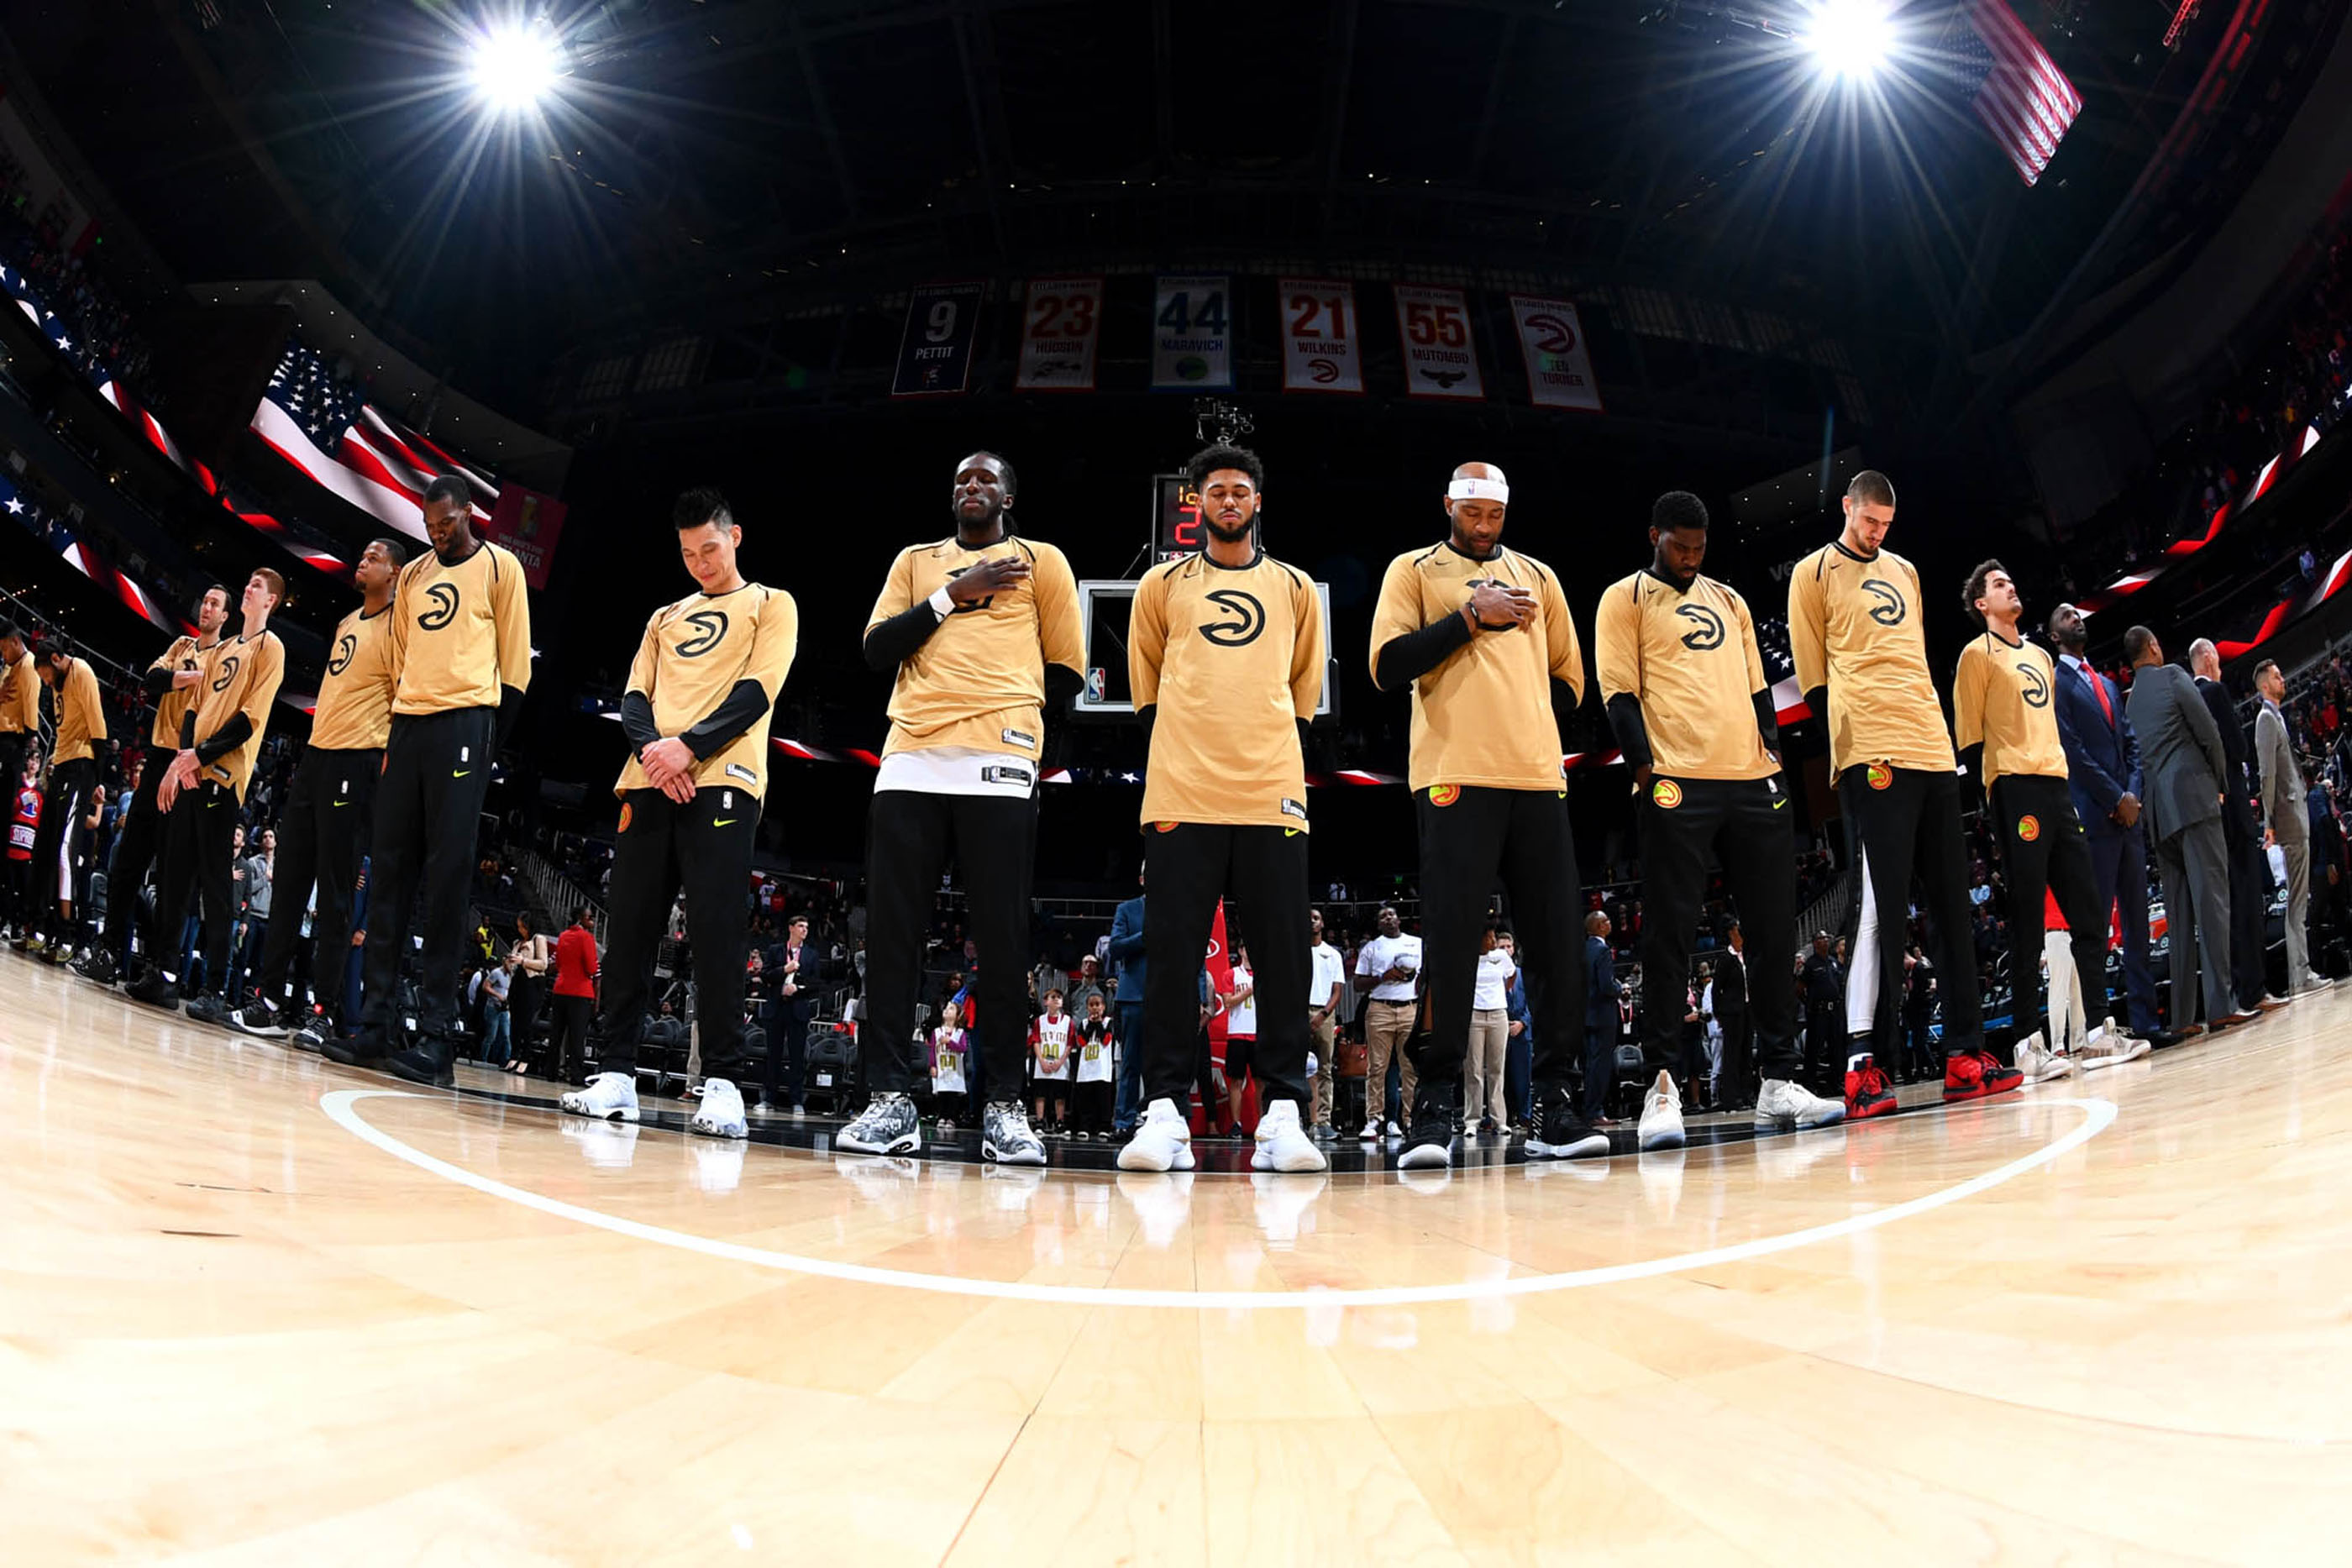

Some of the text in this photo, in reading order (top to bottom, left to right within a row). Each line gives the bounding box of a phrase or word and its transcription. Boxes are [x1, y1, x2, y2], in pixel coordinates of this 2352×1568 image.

[925, 300, 958, 342] 9
[1031, 295, 1094, 338] 23
[1158, 291, 1227, 334] 44
[1290, 295, 1346, 339] 21
[1407, 302, 1466, 348] 55
[915, 346, 954, 360] PETTIT
[1161, 338, 1223, 351] MARAVICH
[1298, 342, 1347, 355] WILKINS
[1412, 348, 1469, 364] MUTOMBO
